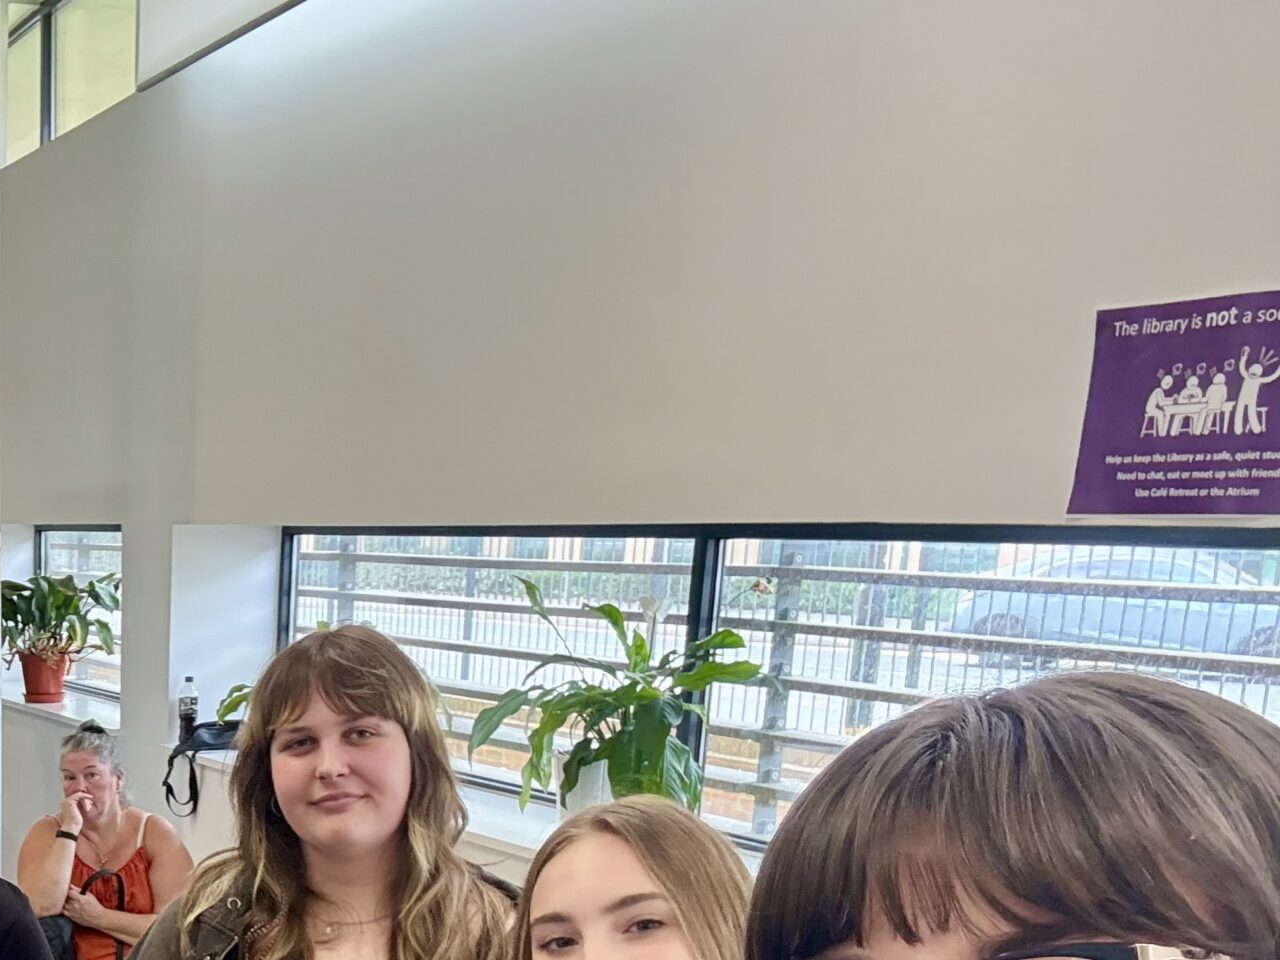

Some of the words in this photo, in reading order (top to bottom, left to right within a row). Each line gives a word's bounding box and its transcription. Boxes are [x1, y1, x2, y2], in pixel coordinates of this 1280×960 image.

[1114, 320, 1139, 337] The
[1142, 317, 1189, 334] library
[1191, 313, 1202, 329] is
[1205, 306, 1238, 328] not
[1242, 311, 1253, 324] a
[1105, 454, 1122, 465] Help
[1123, 455, 1132, 463] us
[1133, 454, 1151, 464] keep
[1152, 453, 1166, 462] the
[1167, 452, 1194, 463] Library
[1195, 453, 1204, 461] as
[1213, 450, 1233, 462] safe,
[1234, 450, 1260, 462] quiet
[1116, 470, 1137, 480] Need
[1137, 471, 1146, 480] to
[1147, 470, 1166, 481] chat,
[1167, 470, 1181, 479] eat
[1181, 471, 1191, 479] or
[1192, 470, 1213, 479] meet
[1214, 471, 1226, 480] up
[1227, 468, 1249, 478] with
[1135, 488, 1150, 498] Use
[1169, 487, 1198, 497] Retreat
[1199, 488, 1209, 497] or
[1210, 487, 1224, 497] the
[1226, 487, 1260, 497] Atrium
